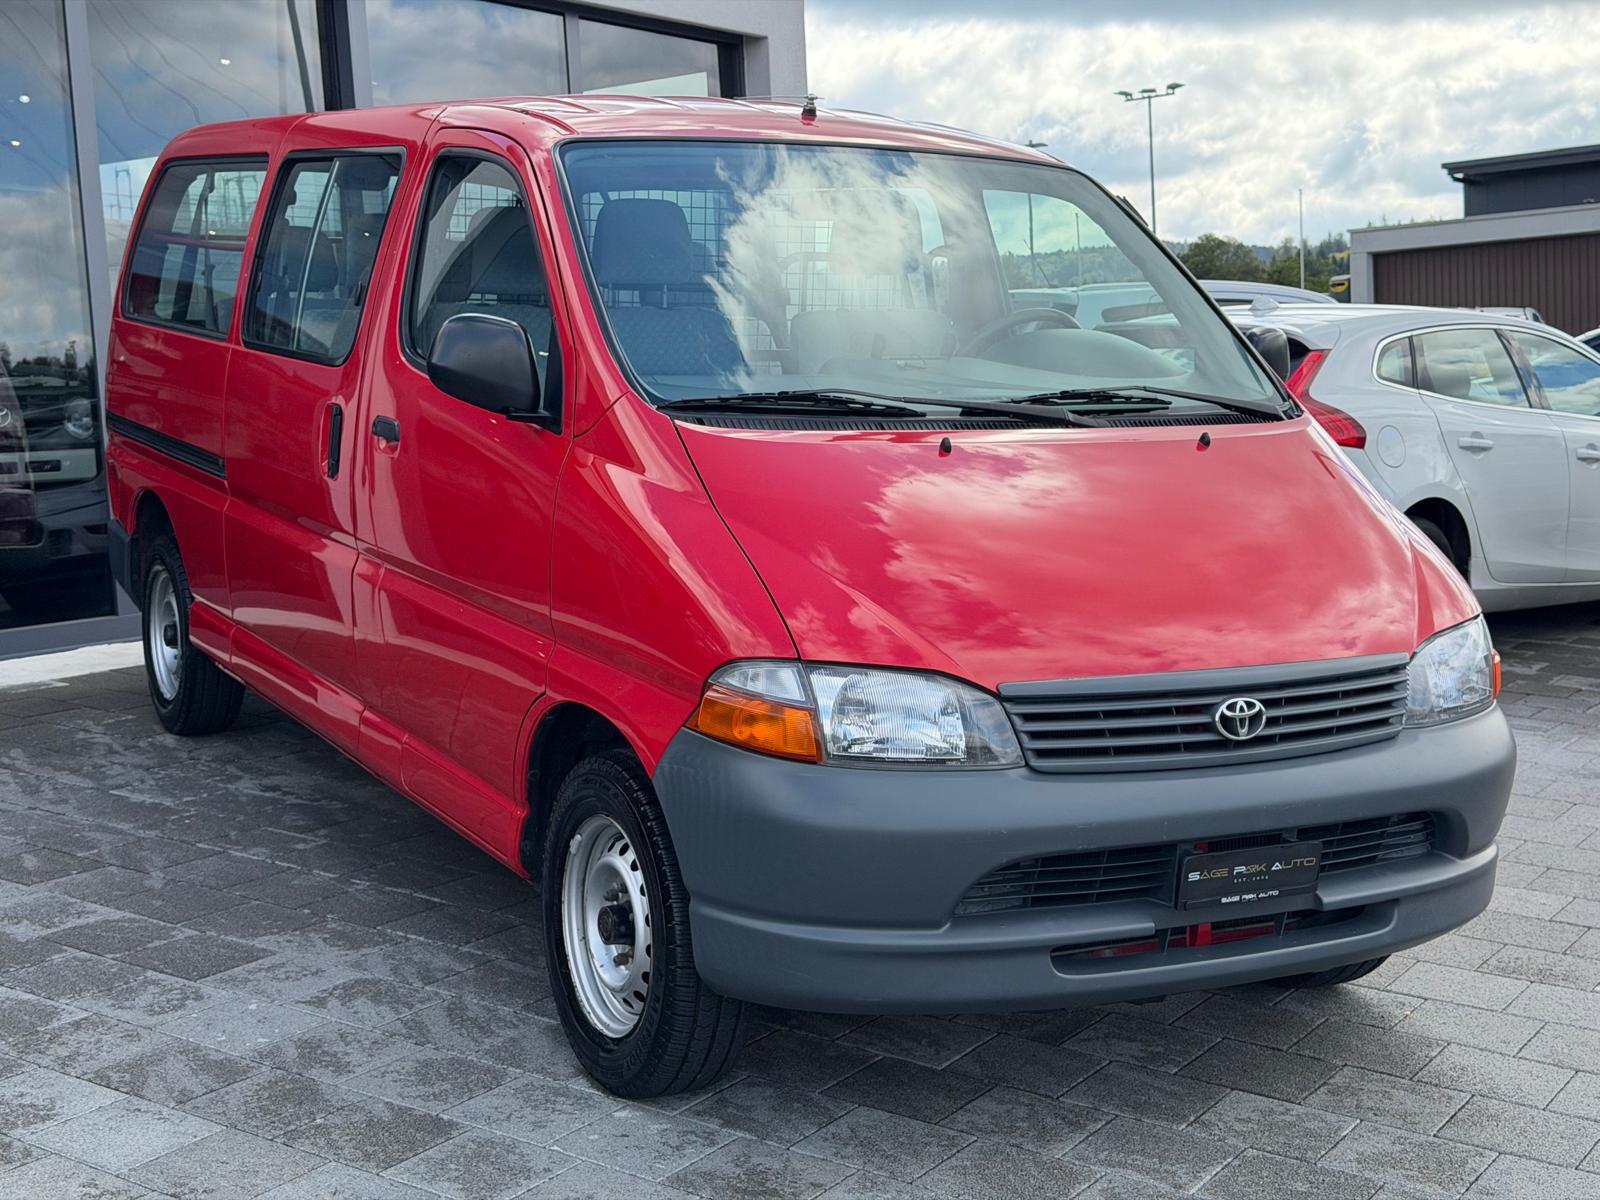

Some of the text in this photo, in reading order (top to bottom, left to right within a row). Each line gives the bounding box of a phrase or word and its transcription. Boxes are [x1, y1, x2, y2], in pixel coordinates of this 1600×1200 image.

[1187, 858, 1316, 882] SAGE PARK AUTO
